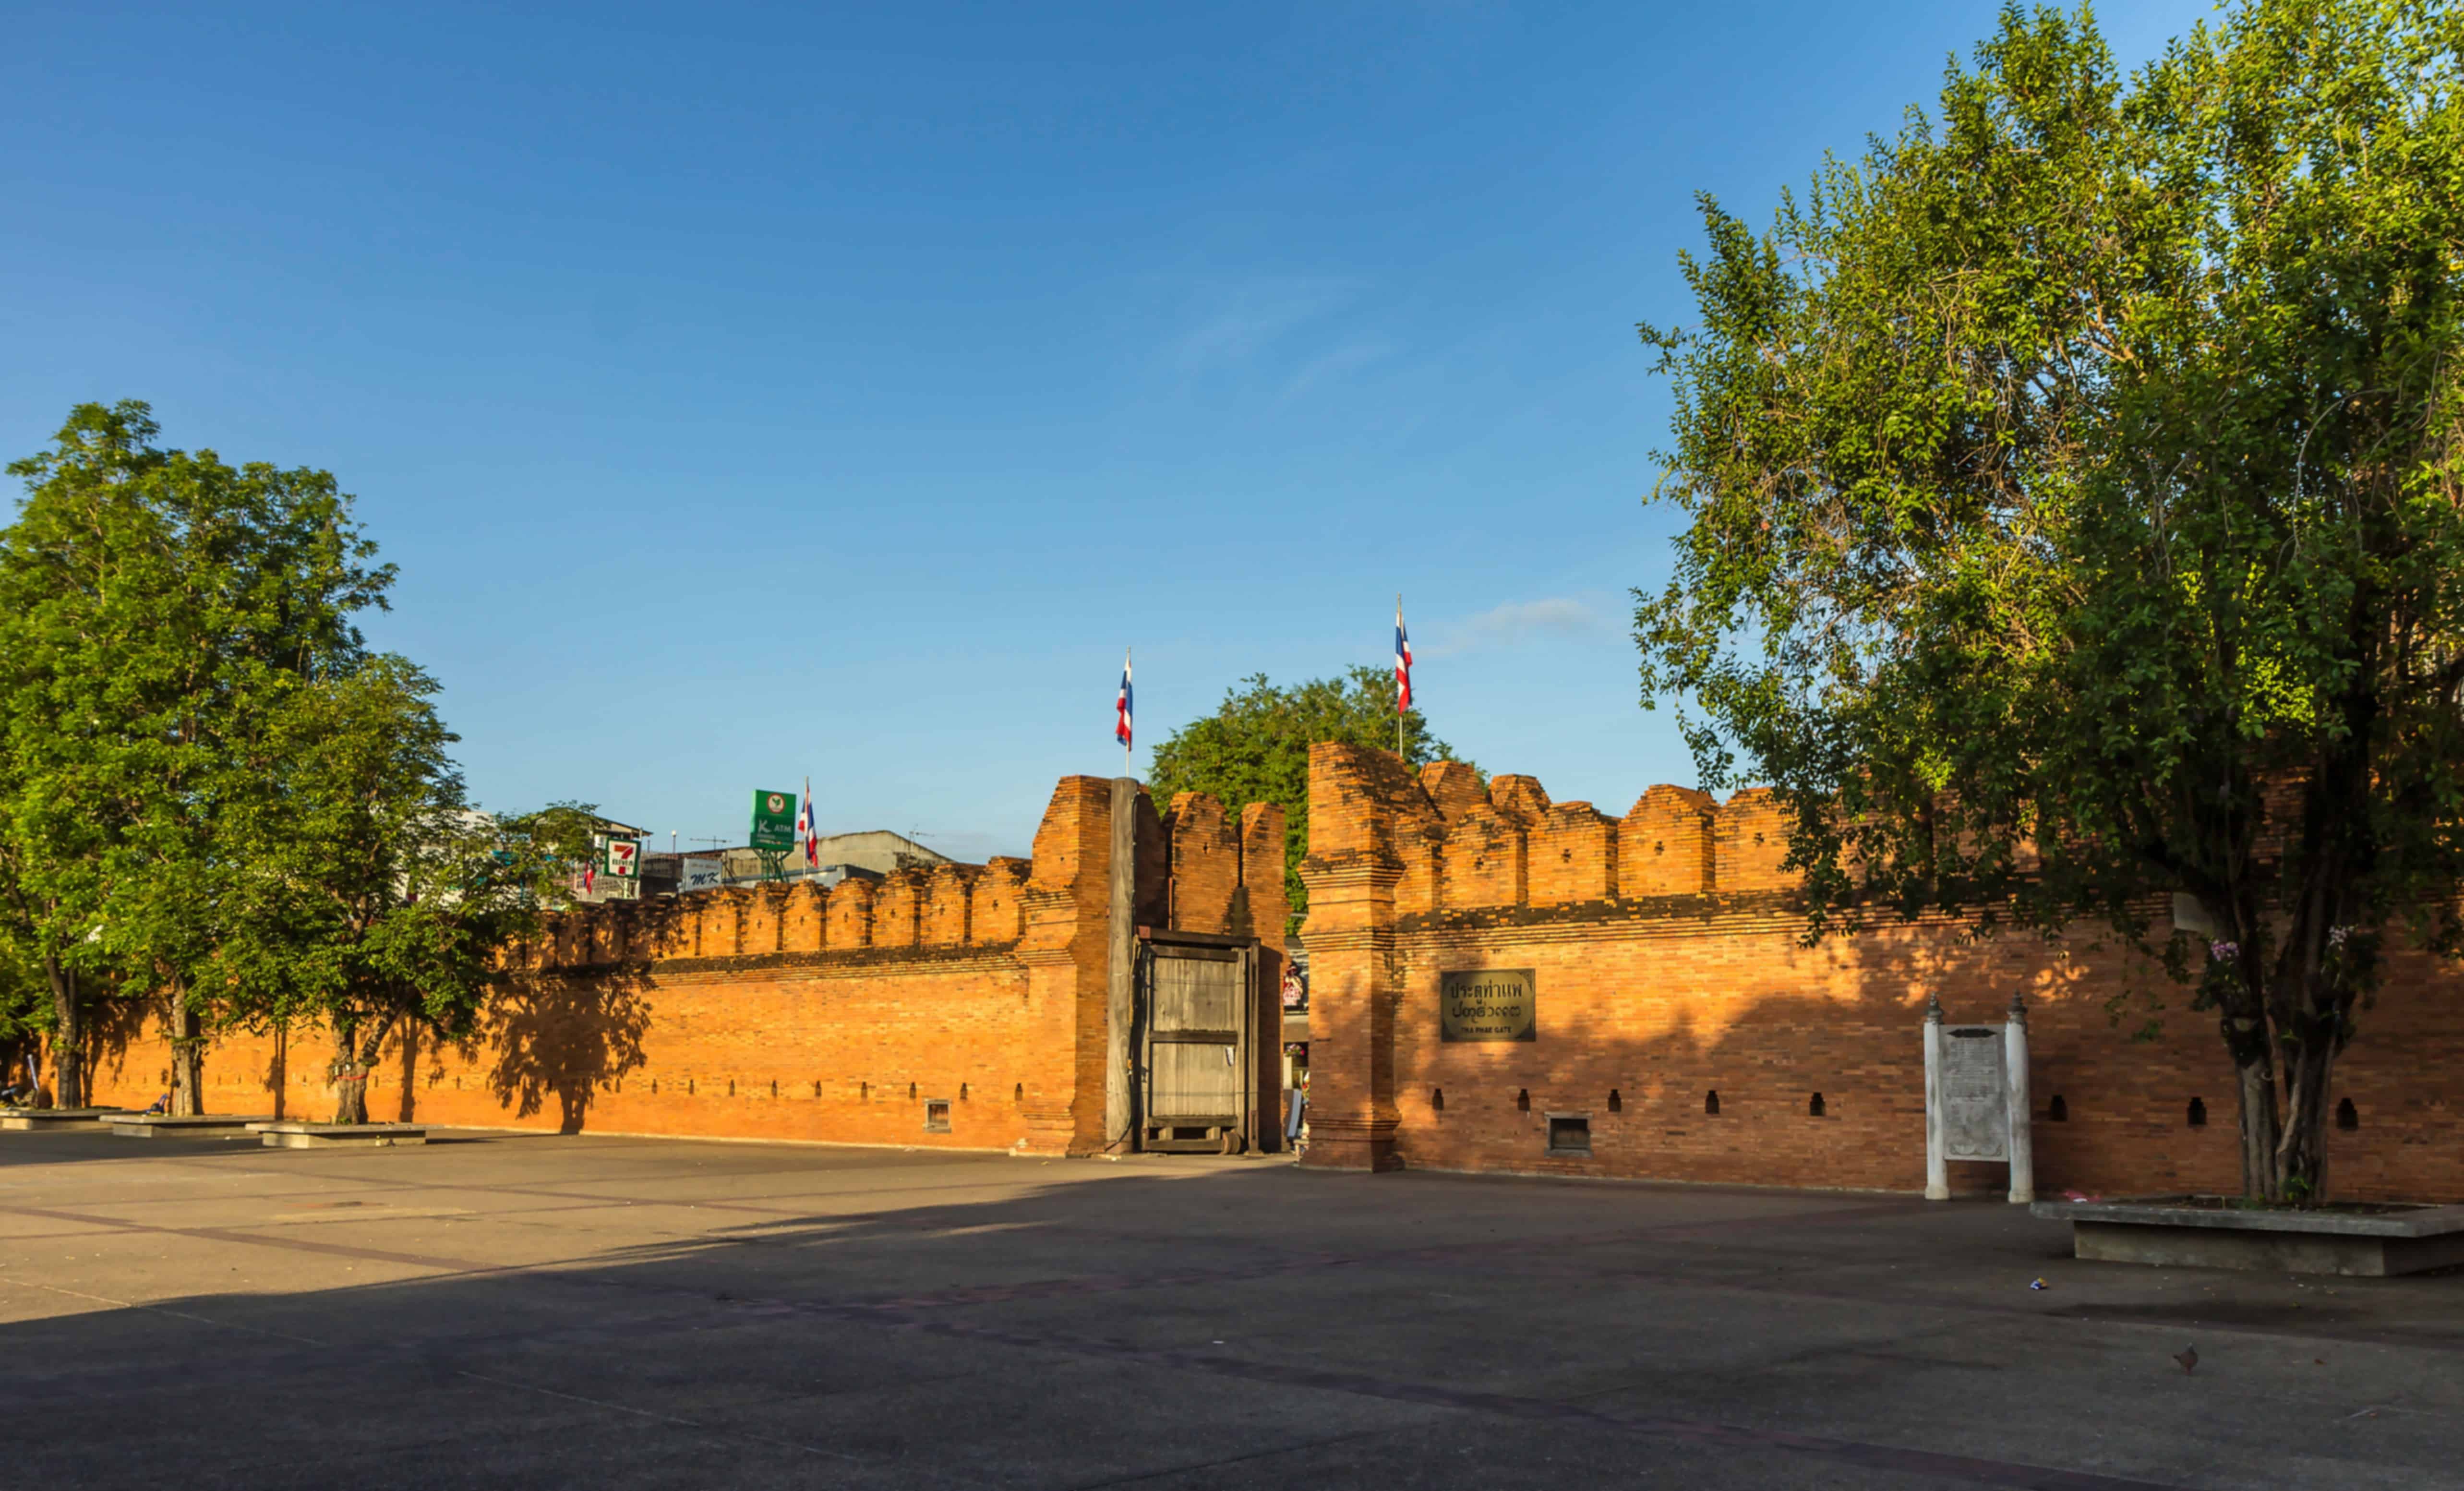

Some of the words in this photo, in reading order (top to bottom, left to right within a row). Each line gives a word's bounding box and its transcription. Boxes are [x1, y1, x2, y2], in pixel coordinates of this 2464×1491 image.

[774, 824, 792, 833] ATM
[614, 844, 634, 875] 7
[1451, 979, 1522, 1004] ประตูท่าแพ
